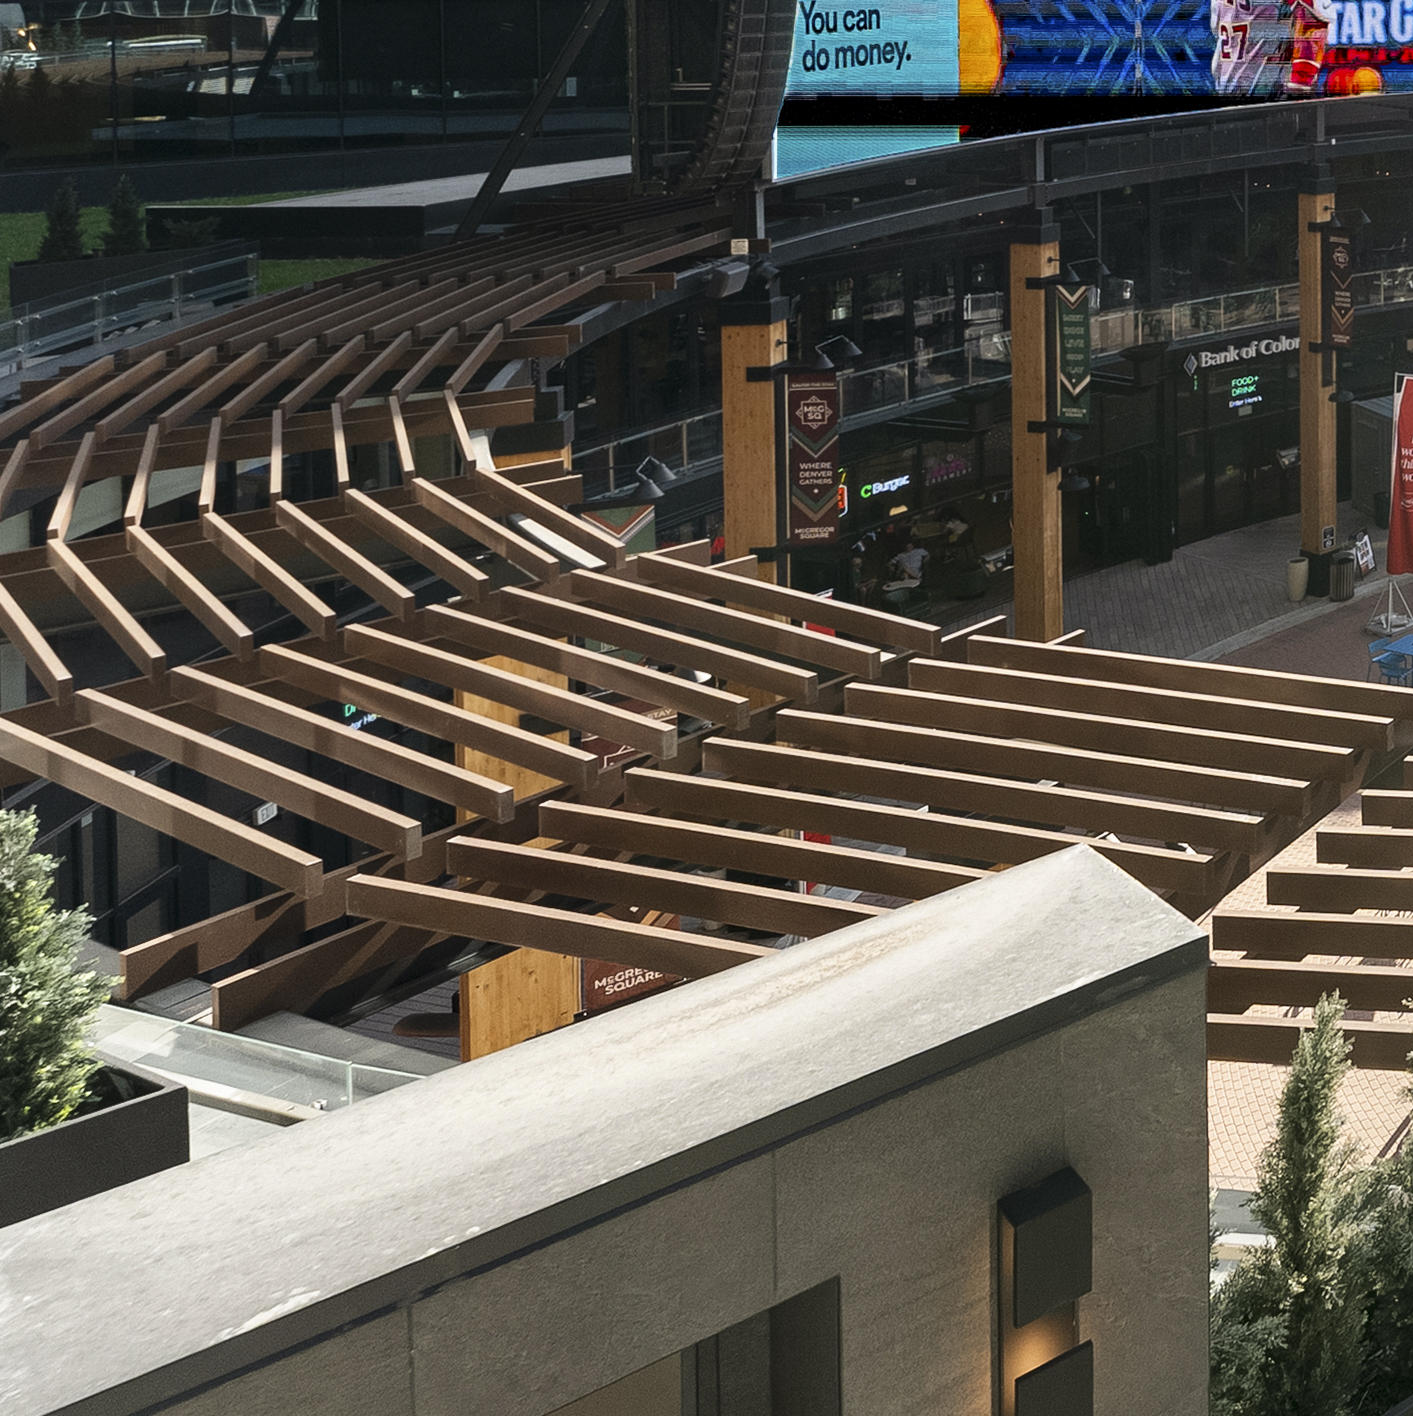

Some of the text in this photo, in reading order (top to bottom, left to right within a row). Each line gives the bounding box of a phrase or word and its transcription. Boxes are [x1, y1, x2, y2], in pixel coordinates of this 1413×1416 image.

[799, 0, 881, 35] You can
[1219, 22, 1249, 62] 27
[802, 40, 912, 72] do money.
[1199, 345, 1240, 368] Bank
[1241, 341, 1259, 359] of
[1231, 384, 1257, 397] DRINK
[807, 412, 823, 420] SQ
[799, 470, 833, 478] DENVER
[799, 477, 833, 485] GATHERS
[594, 967, 649, 990] McGRE
[604, 971, 663, 996] SQUARE
